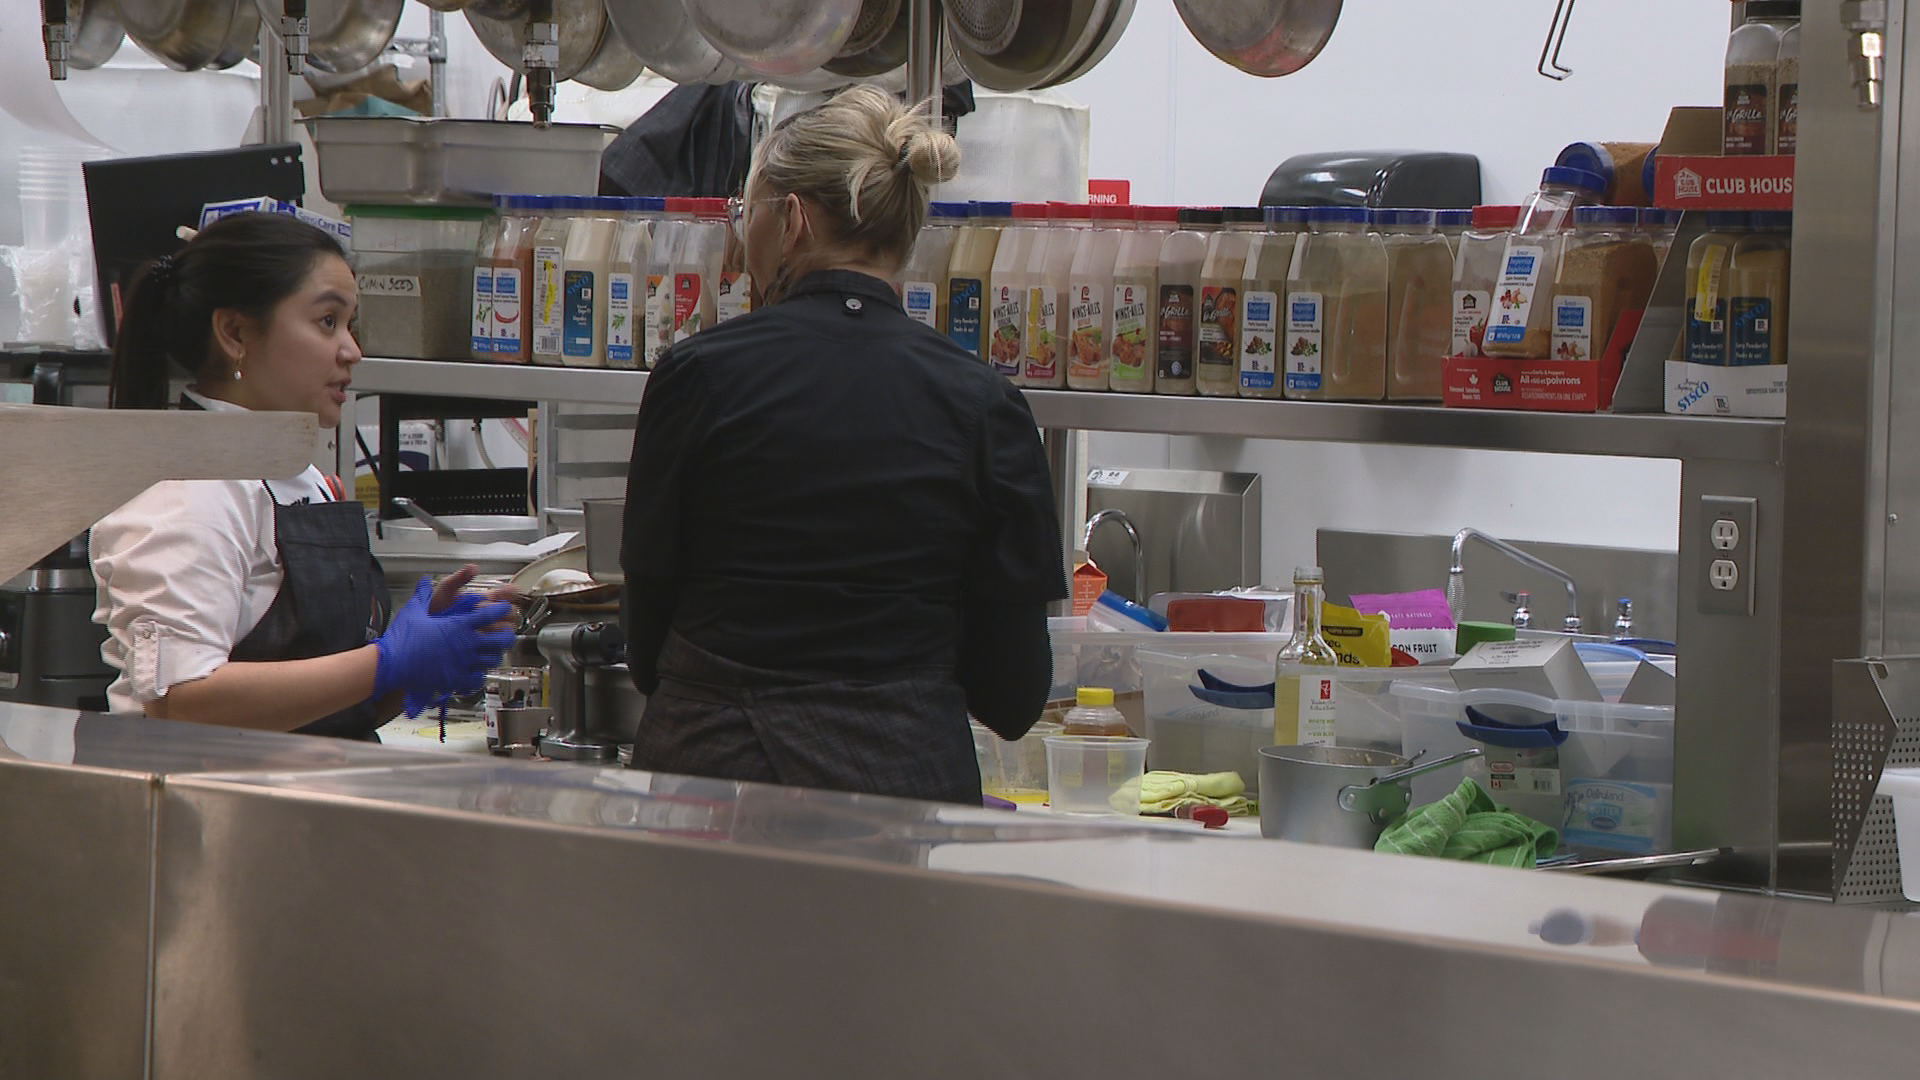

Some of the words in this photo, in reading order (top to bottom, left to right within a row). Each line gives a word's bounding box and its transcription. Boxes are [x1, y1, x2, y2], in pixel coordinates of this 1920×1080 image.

[1705, 178, 1746, 194] CLUB
[1750, 178, 1793, 194] HOUS
[388, 277, 414, 292] SEED
[1546, 376, 1581, 387] poivrons
[1677, 381, 1709, 412] SYSCO
[1413, 644, 1437, 653] FRUIT
[1586, 788, 1624, 802] Dairyland
